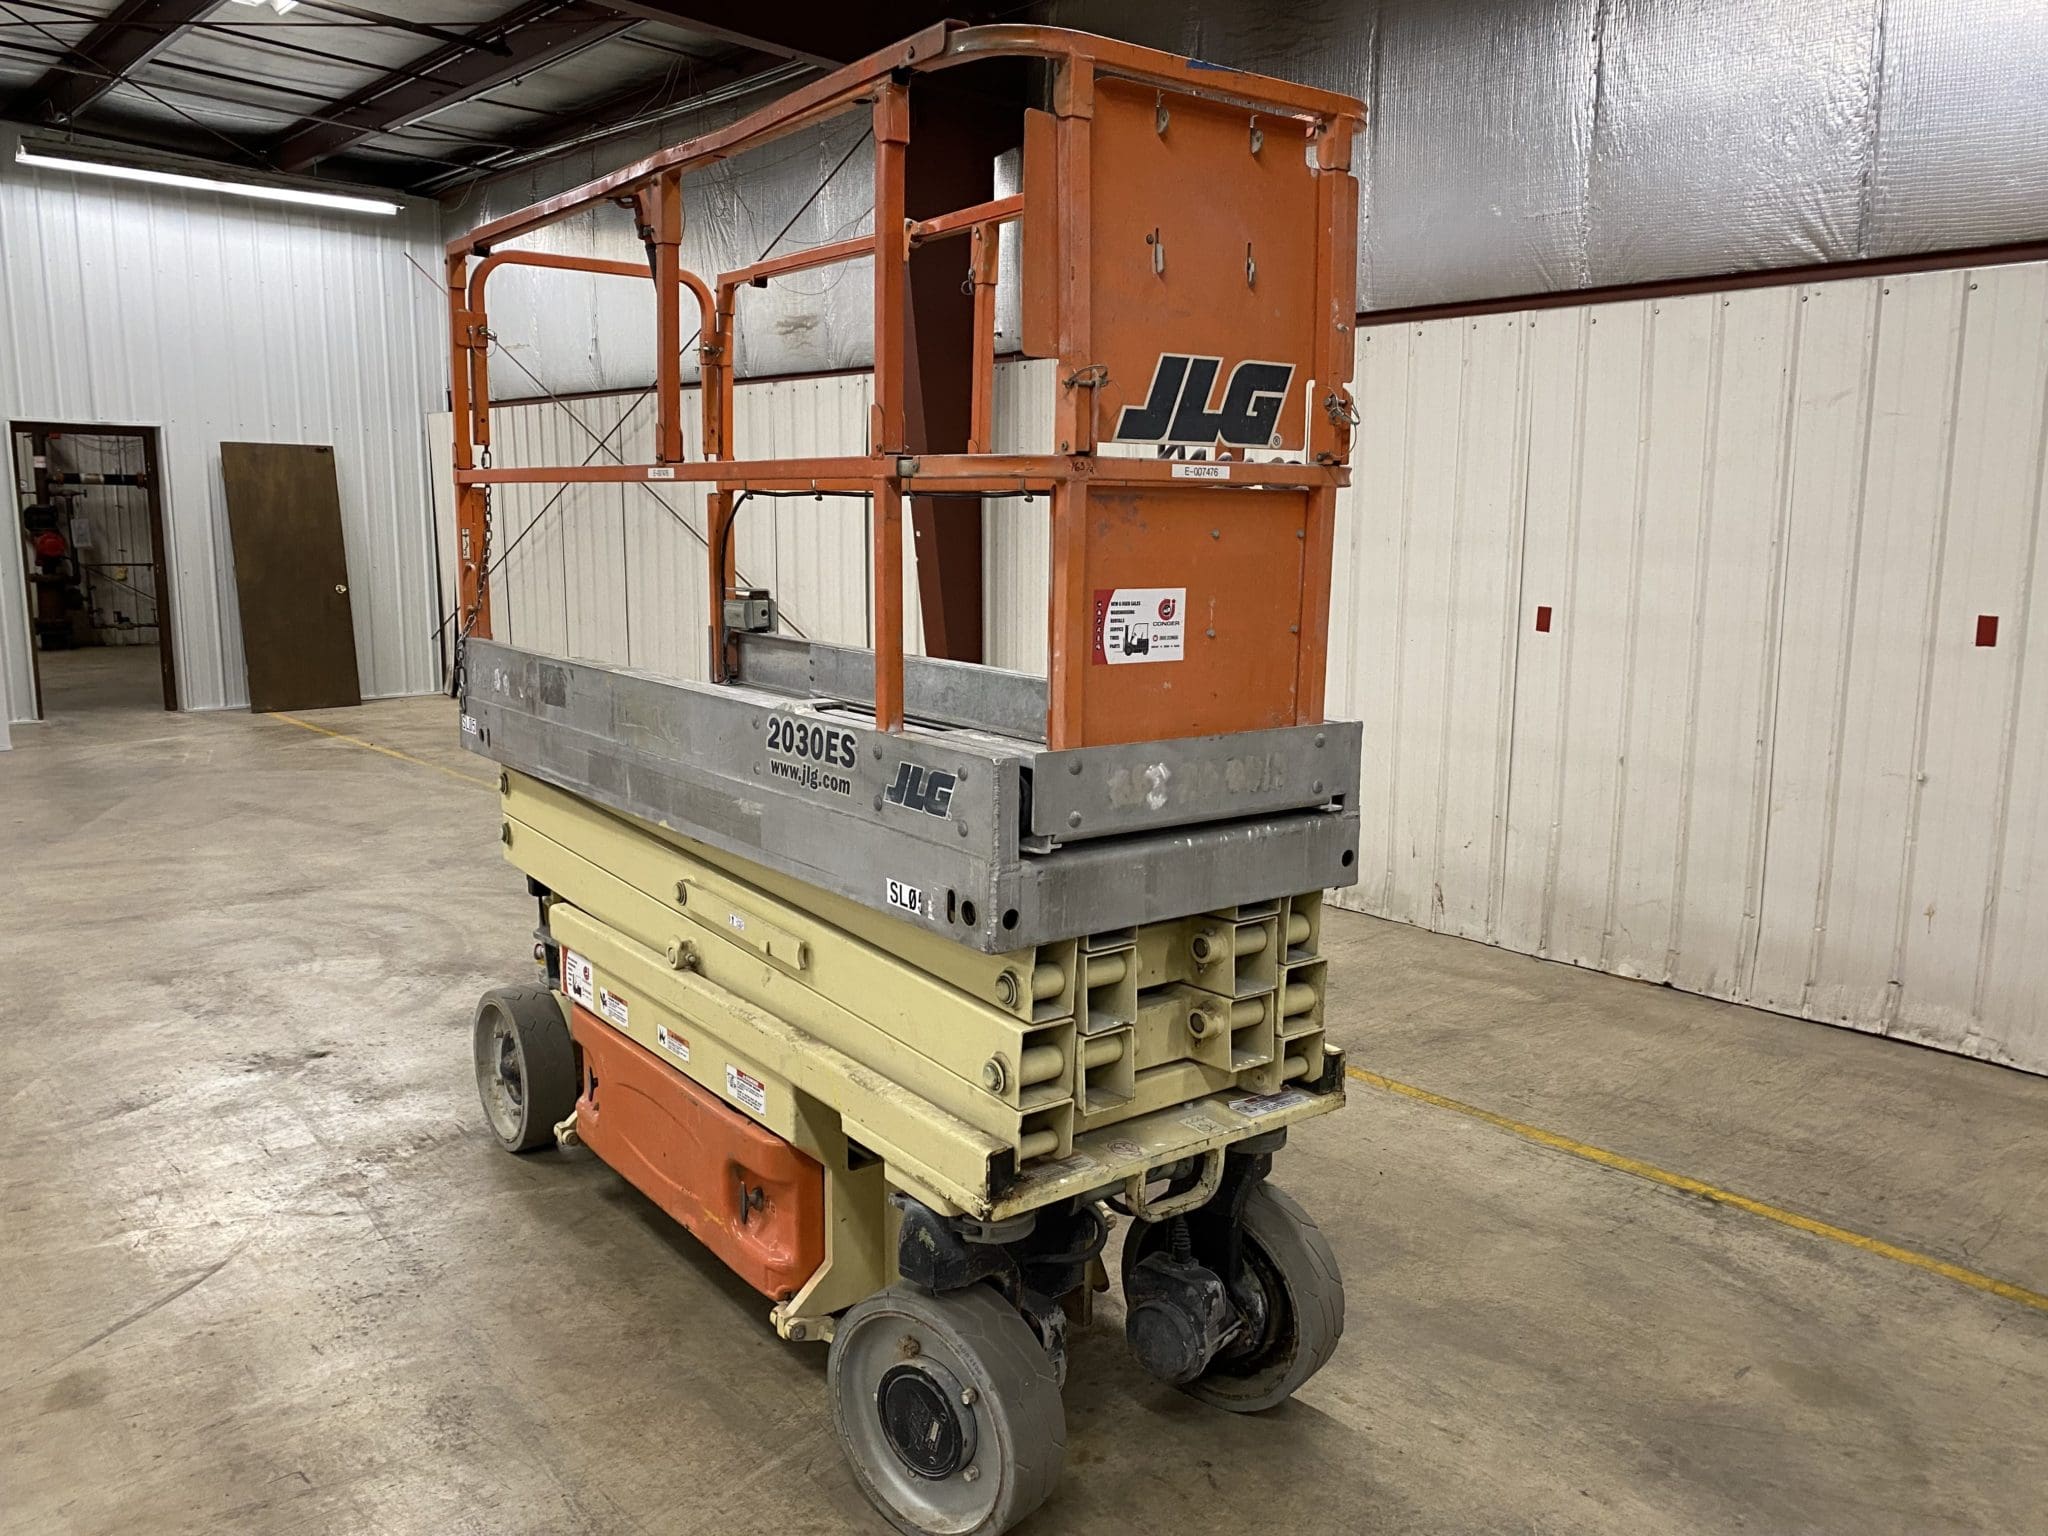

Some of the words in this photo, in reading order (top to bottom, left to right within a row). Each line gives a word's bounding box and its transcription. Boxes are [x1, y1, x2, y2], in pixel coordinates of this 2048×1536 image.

[1113, 353, 1295, 447] JLG
[1184, 466, 1219, 477] E-007476
[767, 717, 856, 769] 2030ES
[770, 759, 851, 796] www.jlg.com
[884, 761, 957, 820] JLG
